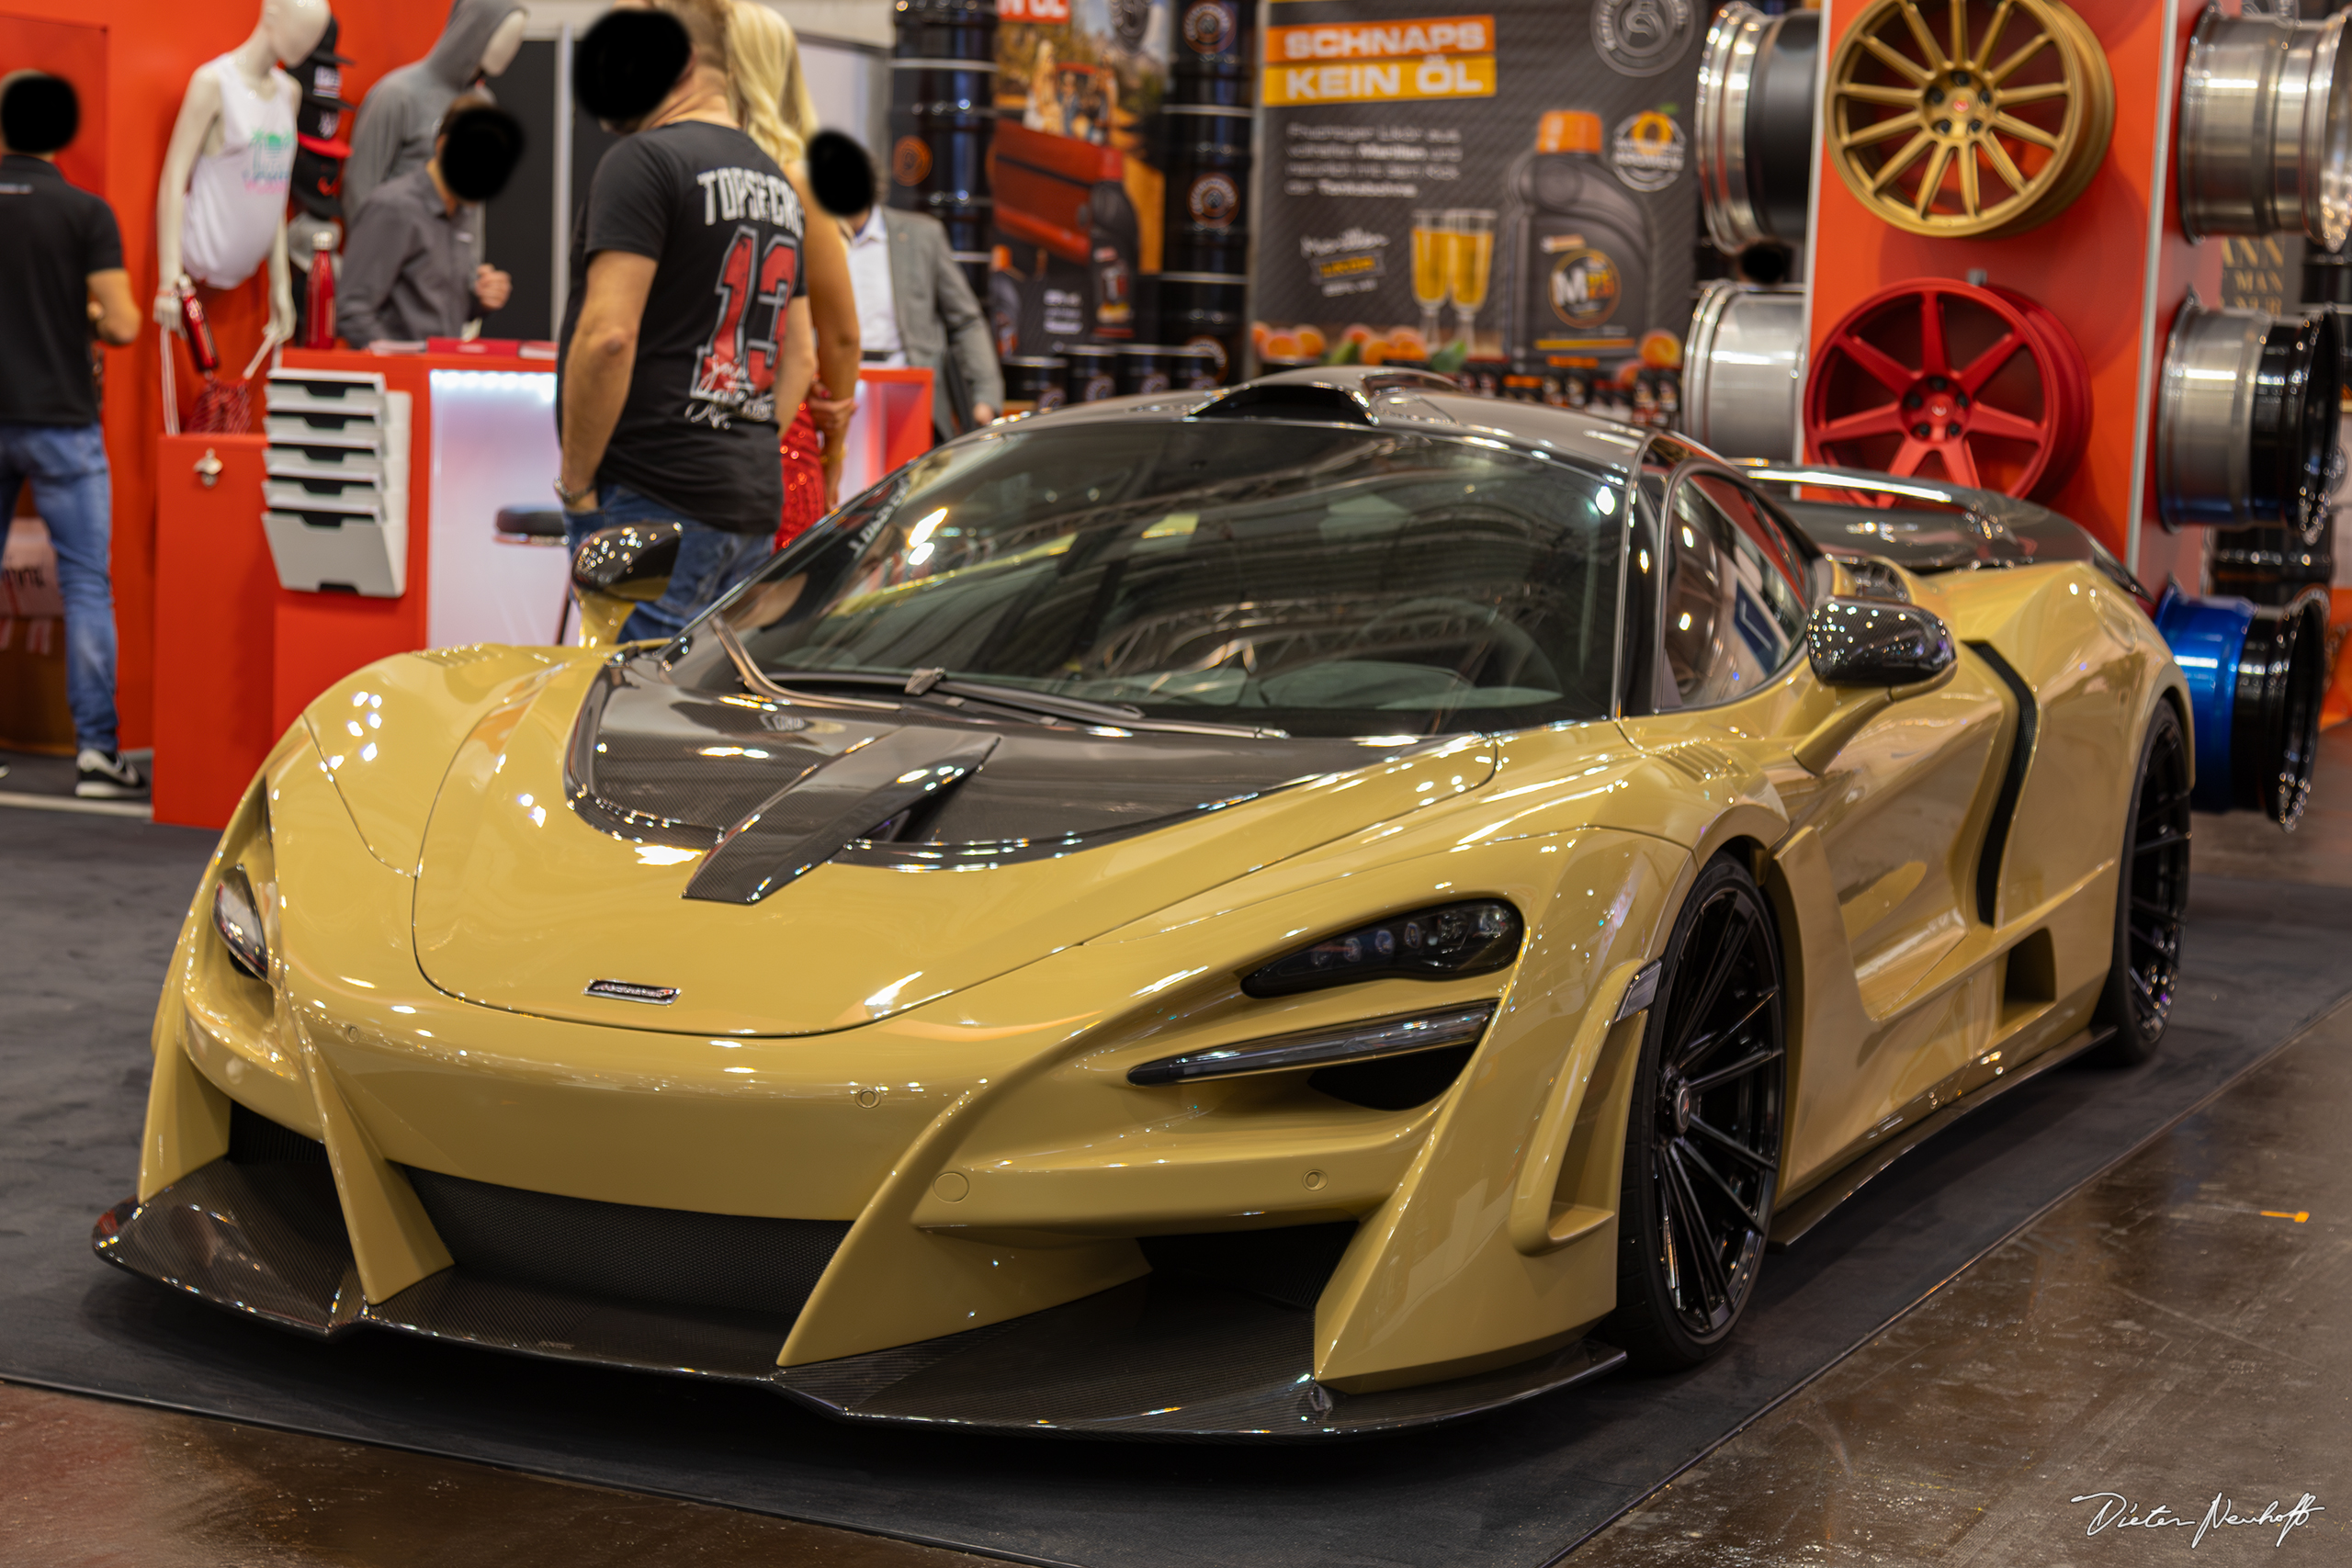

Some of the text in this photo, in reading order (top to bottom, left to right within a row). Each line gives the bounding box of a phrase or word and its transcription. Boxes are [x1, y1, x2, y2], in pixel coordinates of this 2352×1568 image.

[1285, 22, 1486, 58] SCHNAPS
[1287, 53, 1483, 99] KEIN ÖL
[696, 166, 805, 242] TOPSECRE
[690, 223, 801, 397] 13
